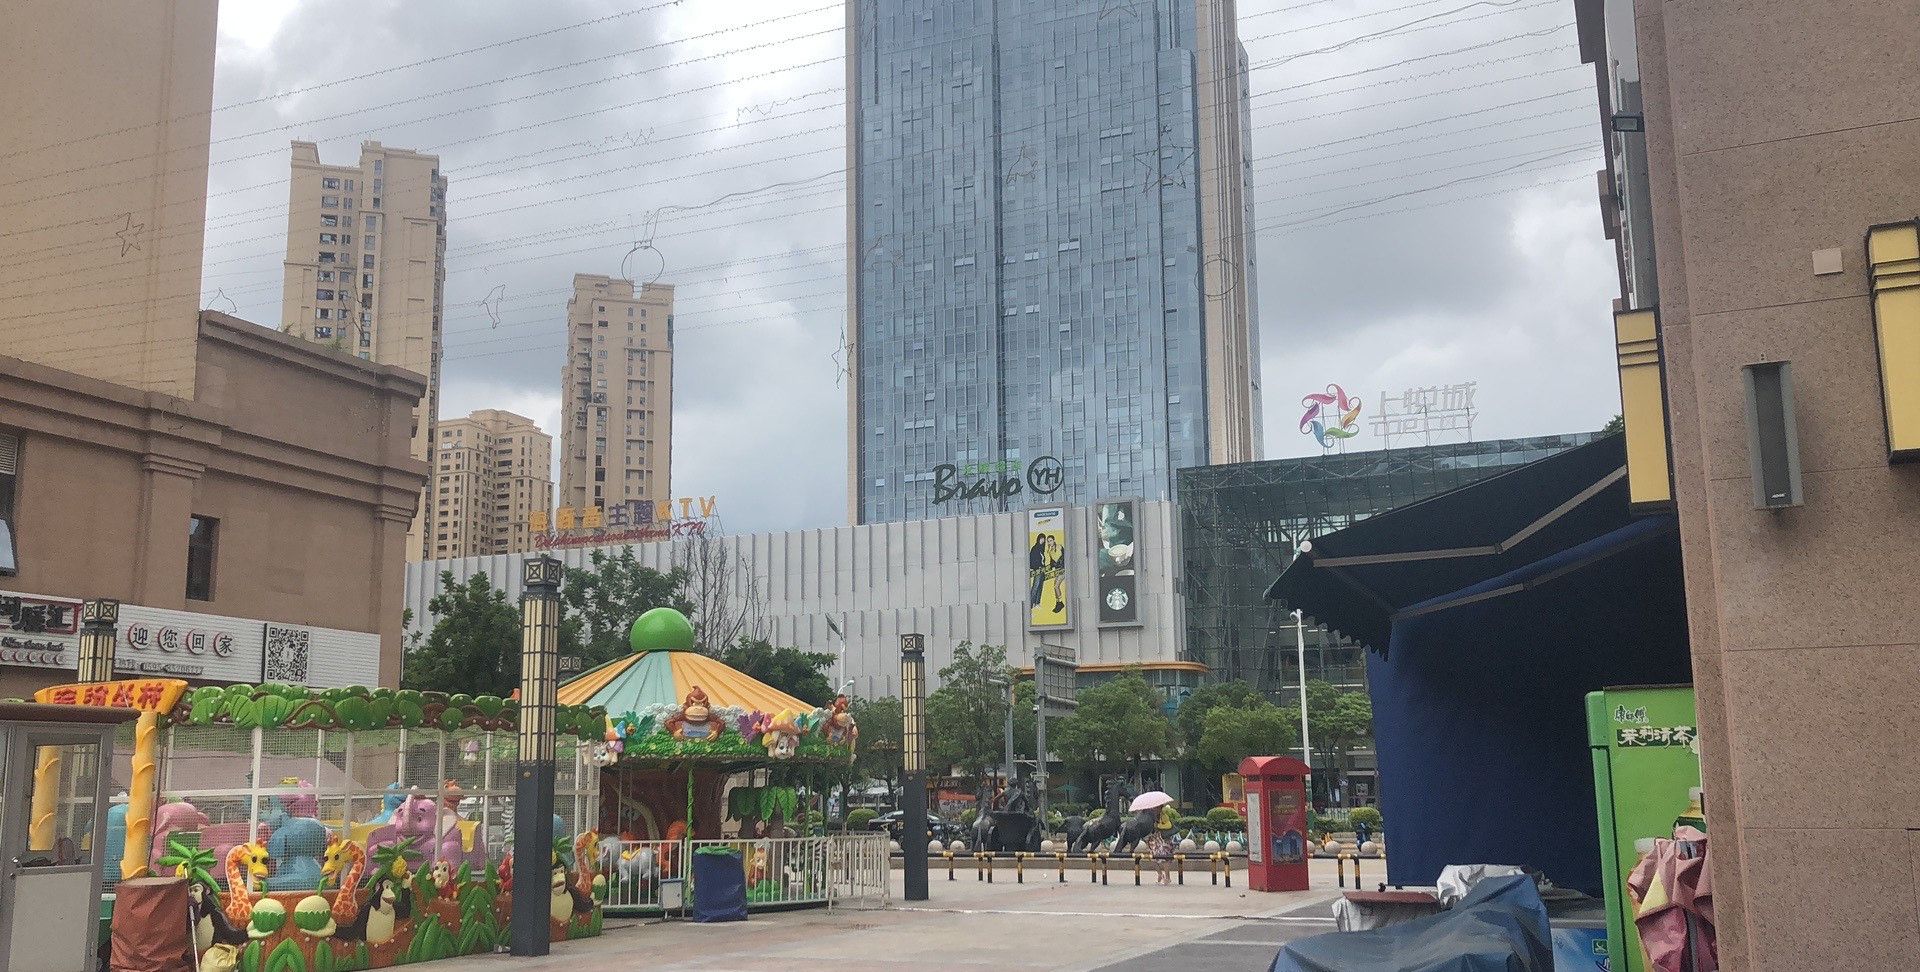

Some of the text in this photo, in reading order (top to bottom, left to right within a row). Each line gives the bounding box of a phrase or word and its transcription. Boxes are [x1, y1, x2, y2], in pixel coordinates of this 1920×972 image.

[932, 463, 1023, 505] Bravo
[132, 626, 234, 655] 迎您回家
[1614, 704, 1648, 723] 康师傅
[1618, 725, 1694, 749] 茉莉清茶
